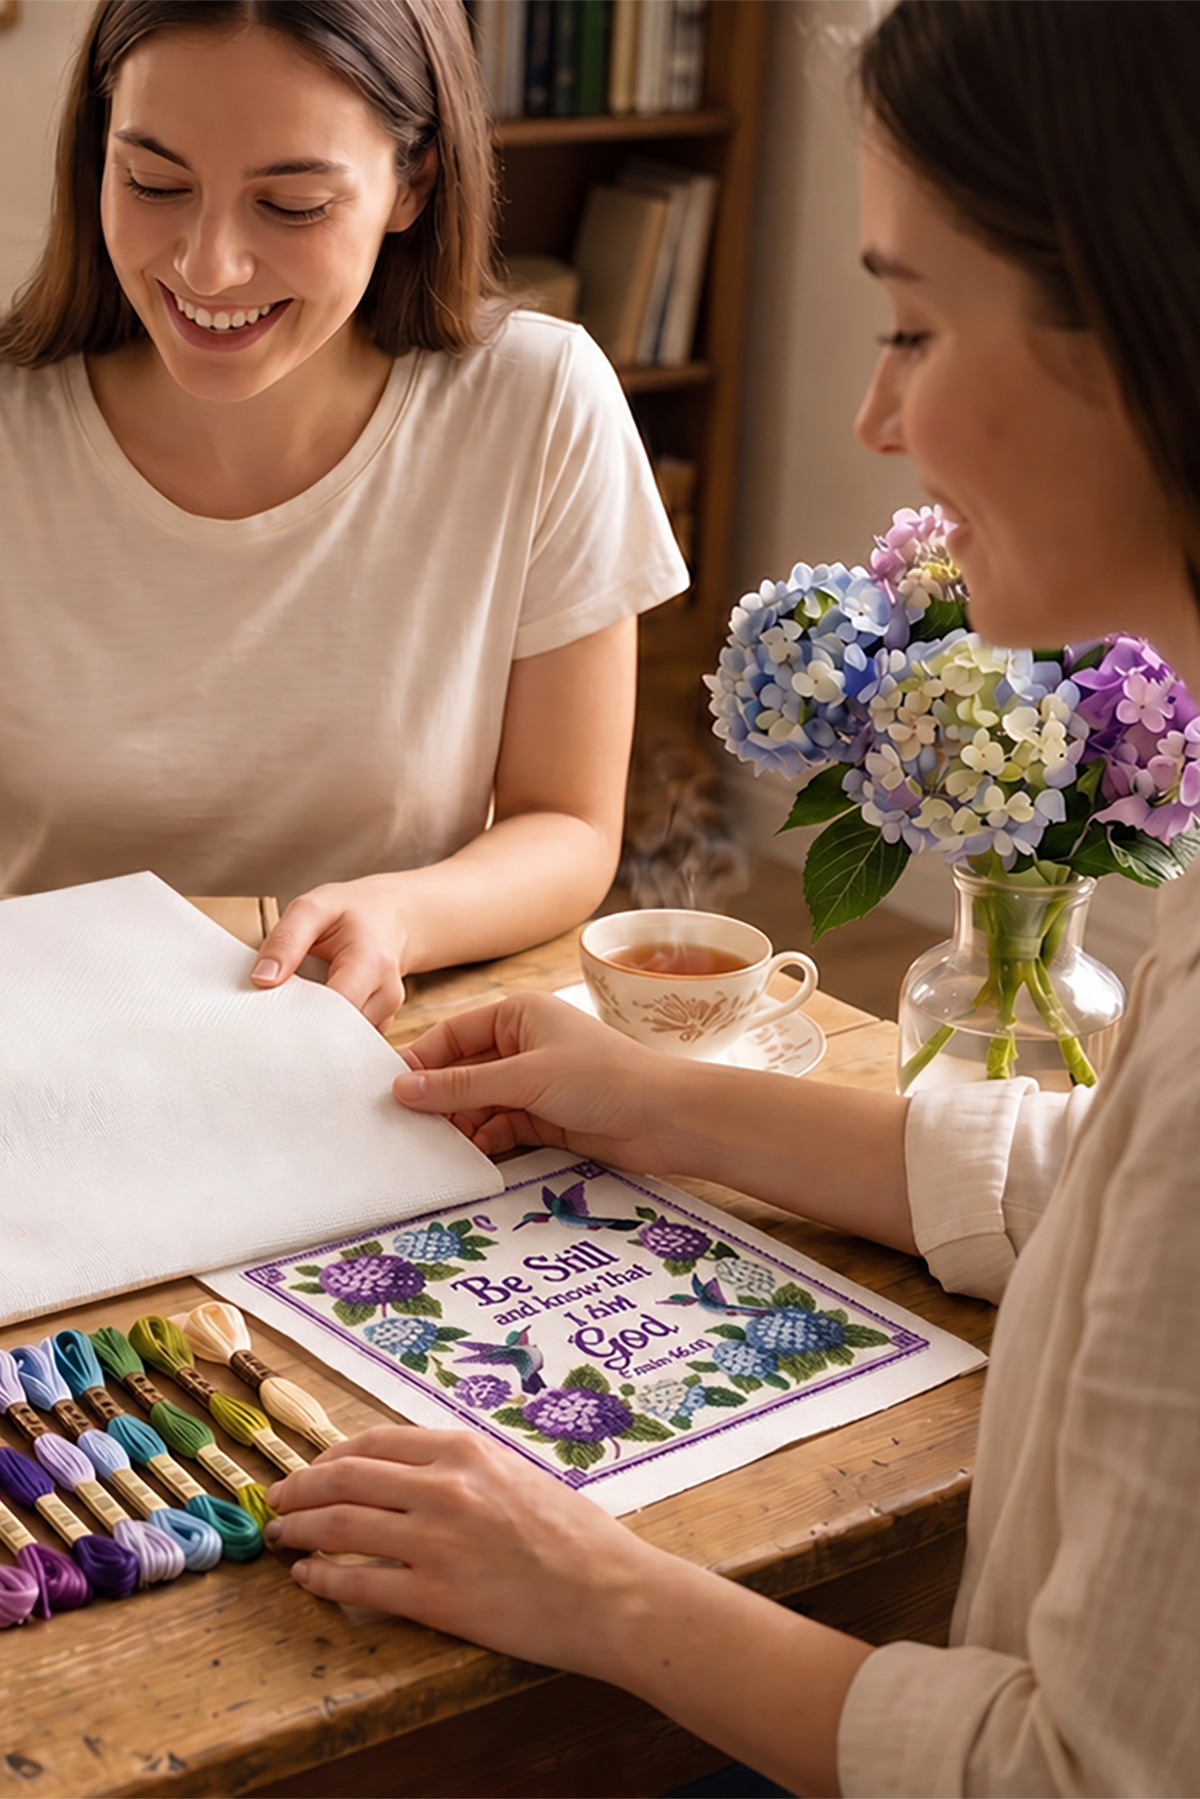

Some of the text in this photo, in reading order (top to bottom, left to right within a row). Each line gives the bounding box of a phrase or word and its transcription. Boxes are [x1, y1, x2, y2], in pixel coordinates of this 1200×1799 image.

[450, 1240, 620, 1306] Be Still
[493, 1300, 541, 1325] and
[532, 1283, 601, 1310] know
[564, 1311, 588, 1327] I
[567, 1313, 679, 1370] God
